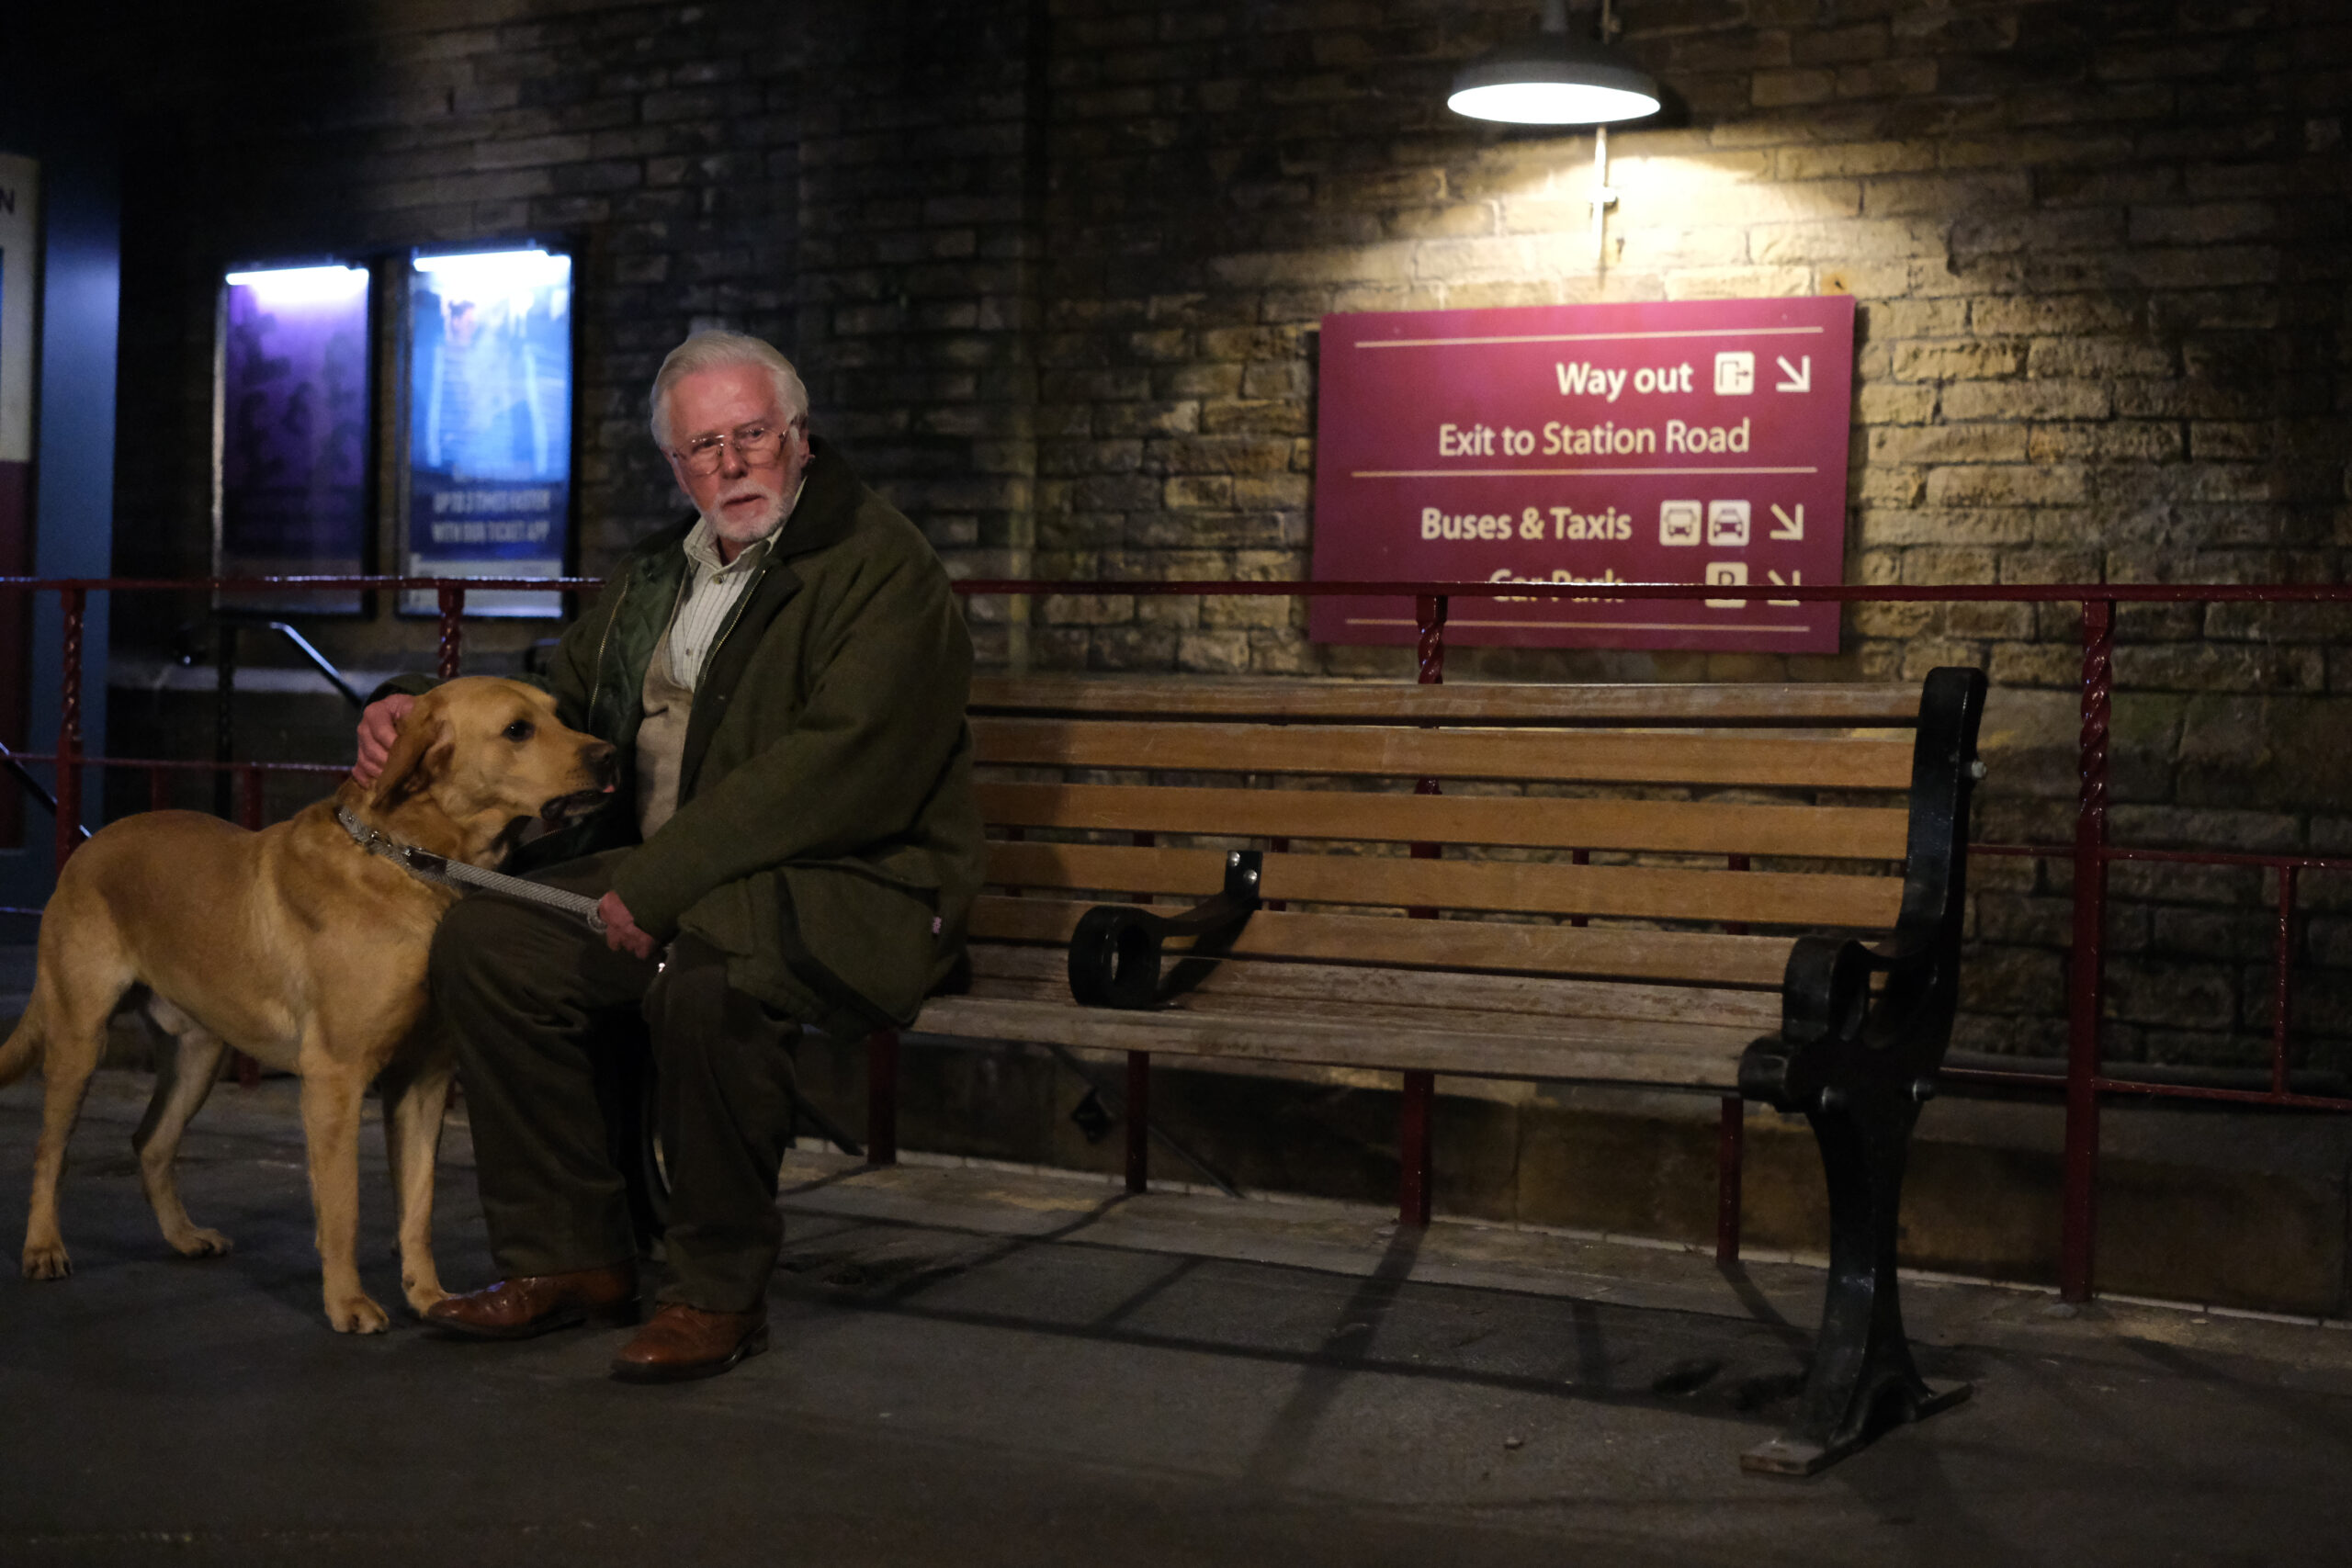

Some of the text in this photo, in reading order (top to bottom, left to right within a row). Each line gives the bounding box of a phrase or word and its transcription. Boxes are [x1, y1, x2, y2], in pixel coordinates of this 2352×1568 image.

[1555, 362, 1693, 402] Way out
[1439, 416, 1750, 456] Exit to Station Road
[1421, 506, 1632, 540] Buses & Taxis
